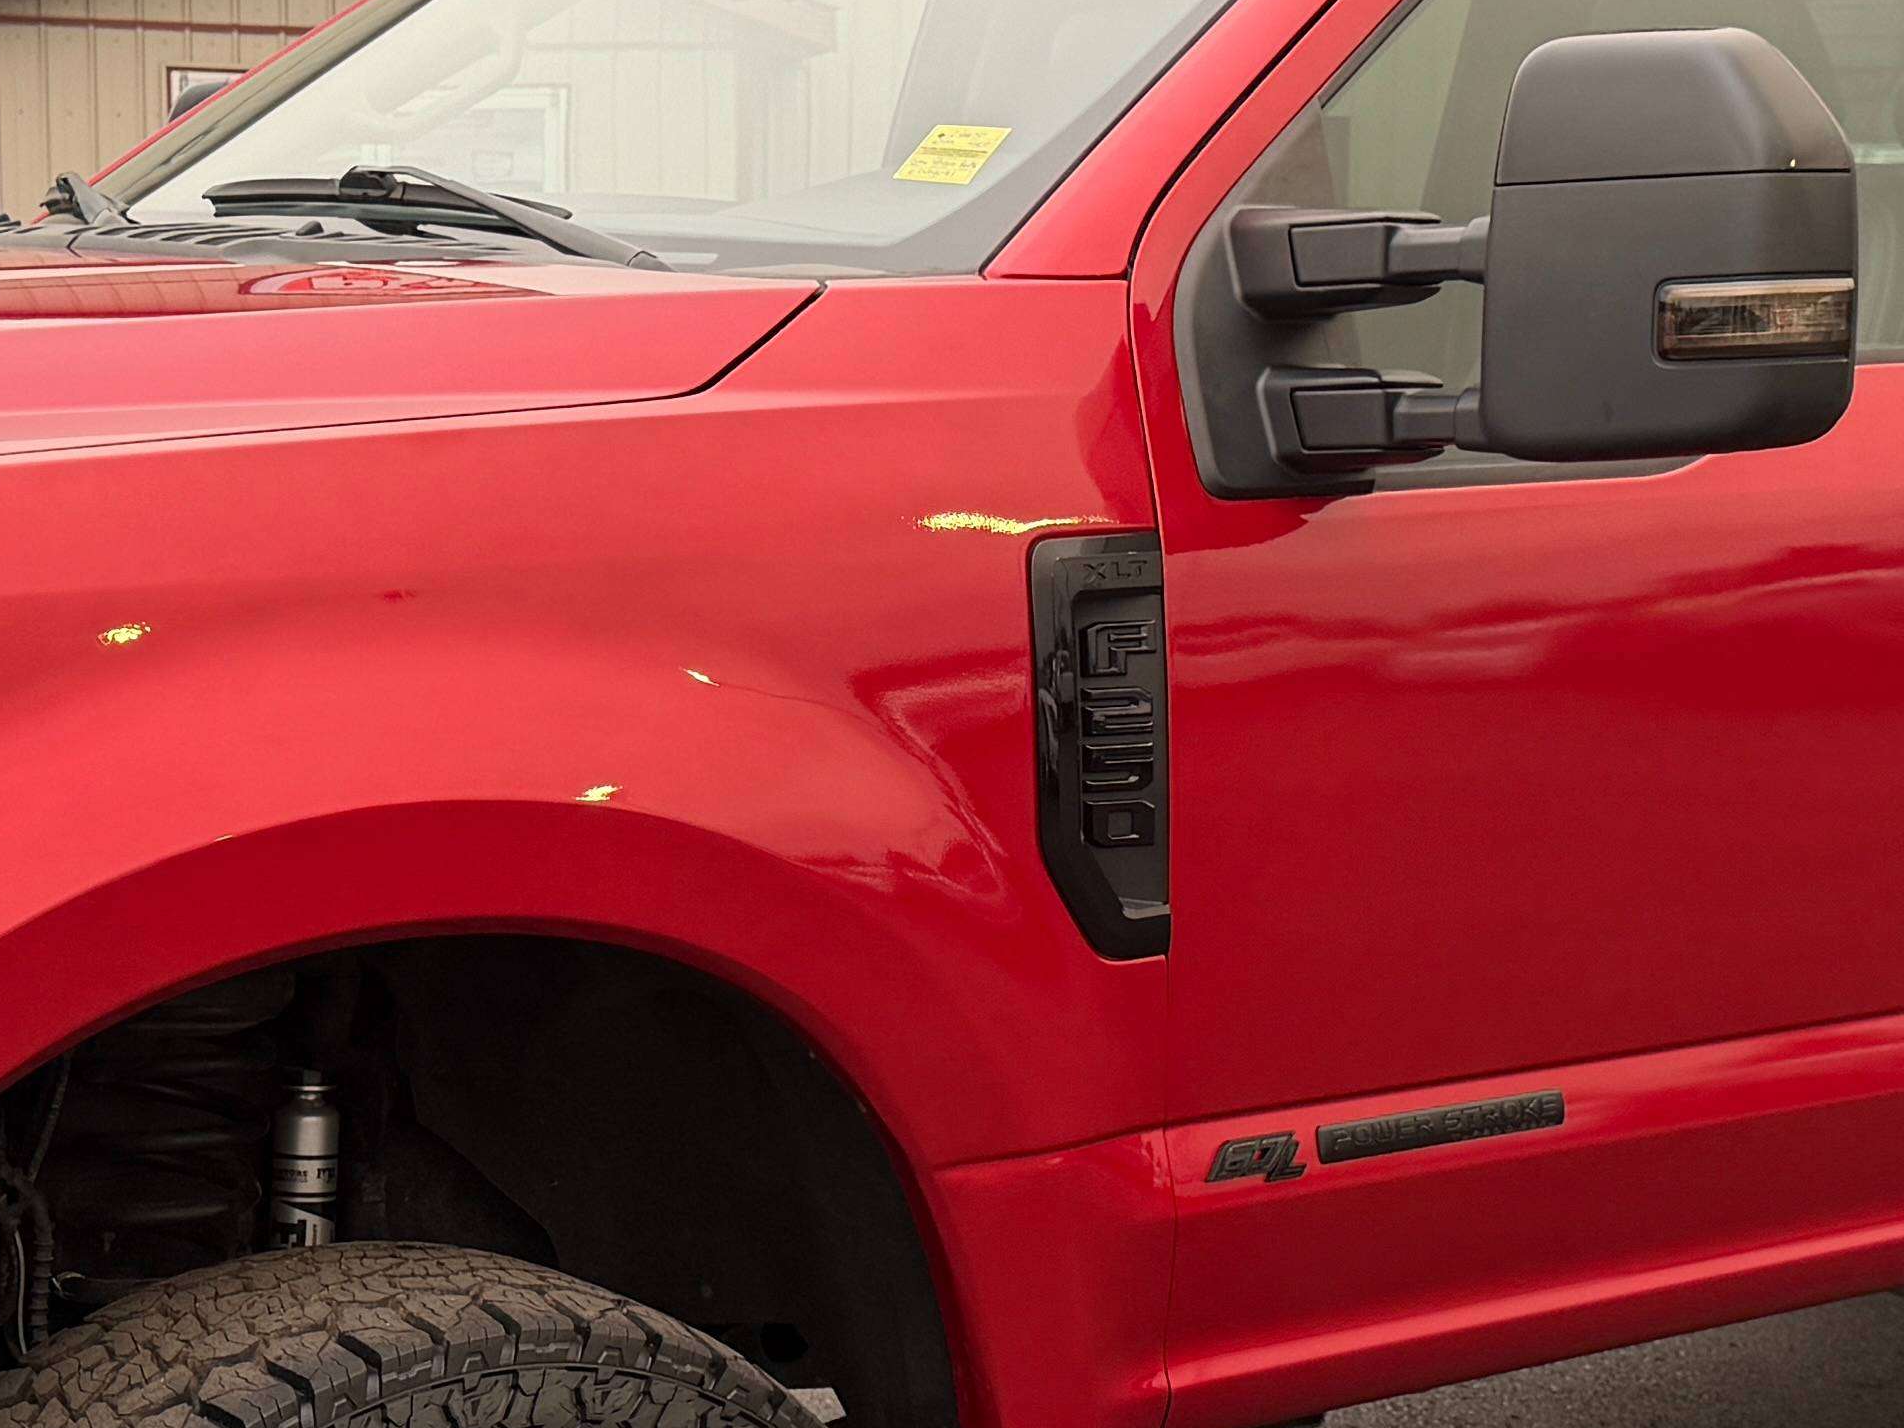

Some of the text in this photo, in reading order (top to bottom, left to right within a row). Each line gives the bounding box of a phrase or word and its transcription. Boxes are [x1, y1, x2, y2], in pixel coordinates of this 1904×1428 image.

[1083, 560, 1148, 583] XLT
[1332, 1120, 1435, 1151] POWER
[1446, 1097, 1560, 1132] STROKE
